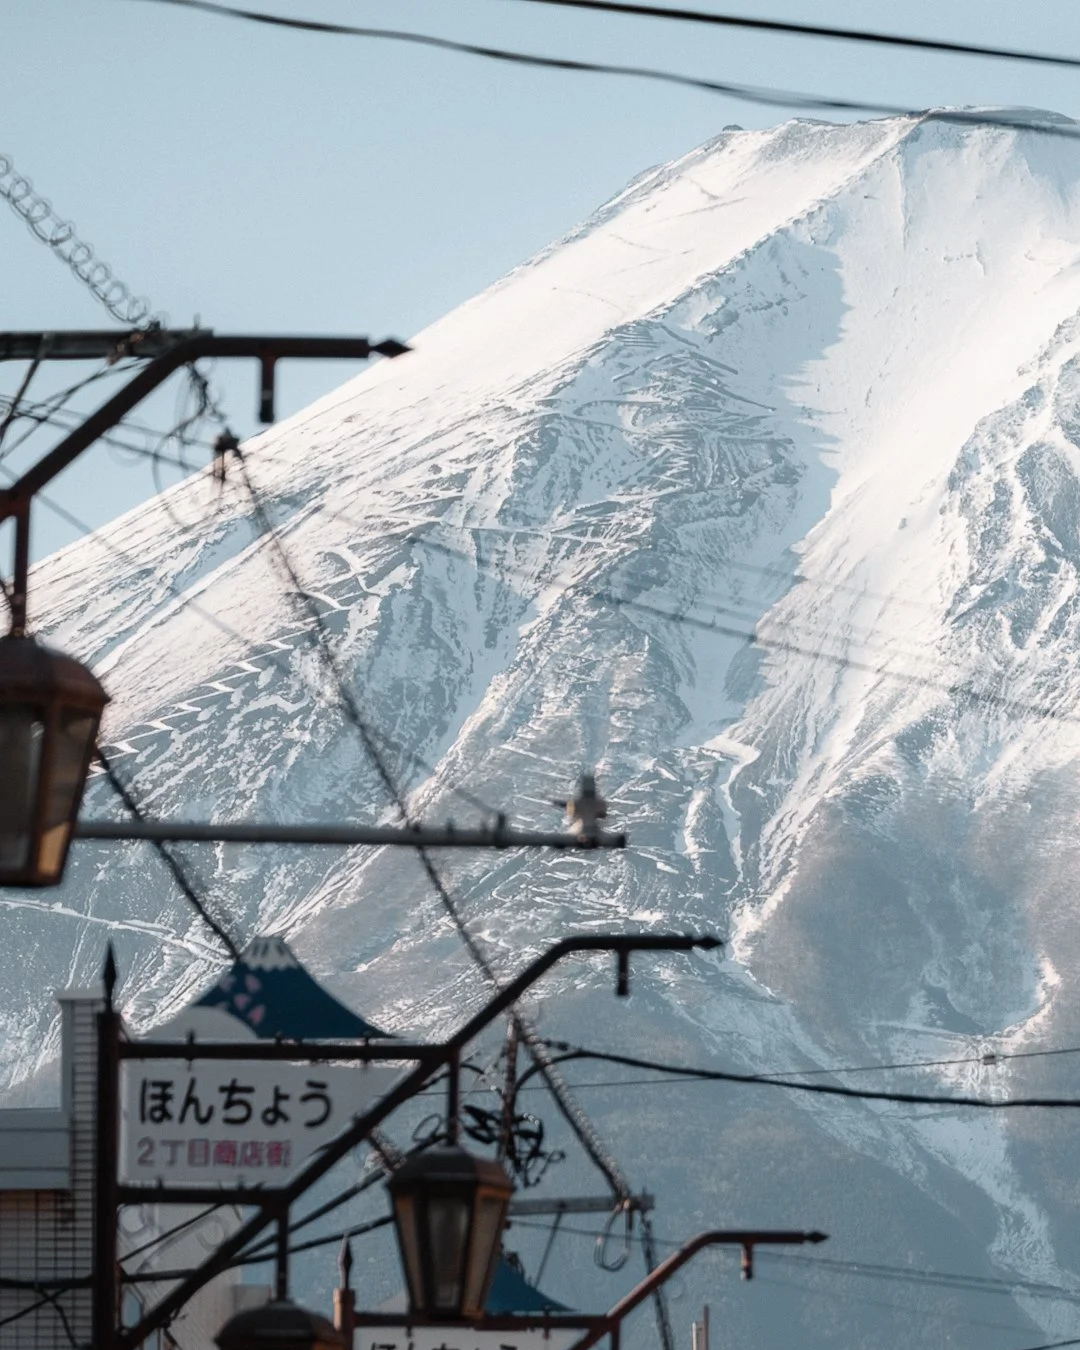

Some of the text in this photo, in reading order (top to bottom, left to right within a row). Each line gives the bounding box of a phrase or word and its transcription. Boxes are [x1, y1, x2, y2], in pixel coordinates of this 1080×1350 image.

[140, 1077, 332, 1128] ほんちょう
